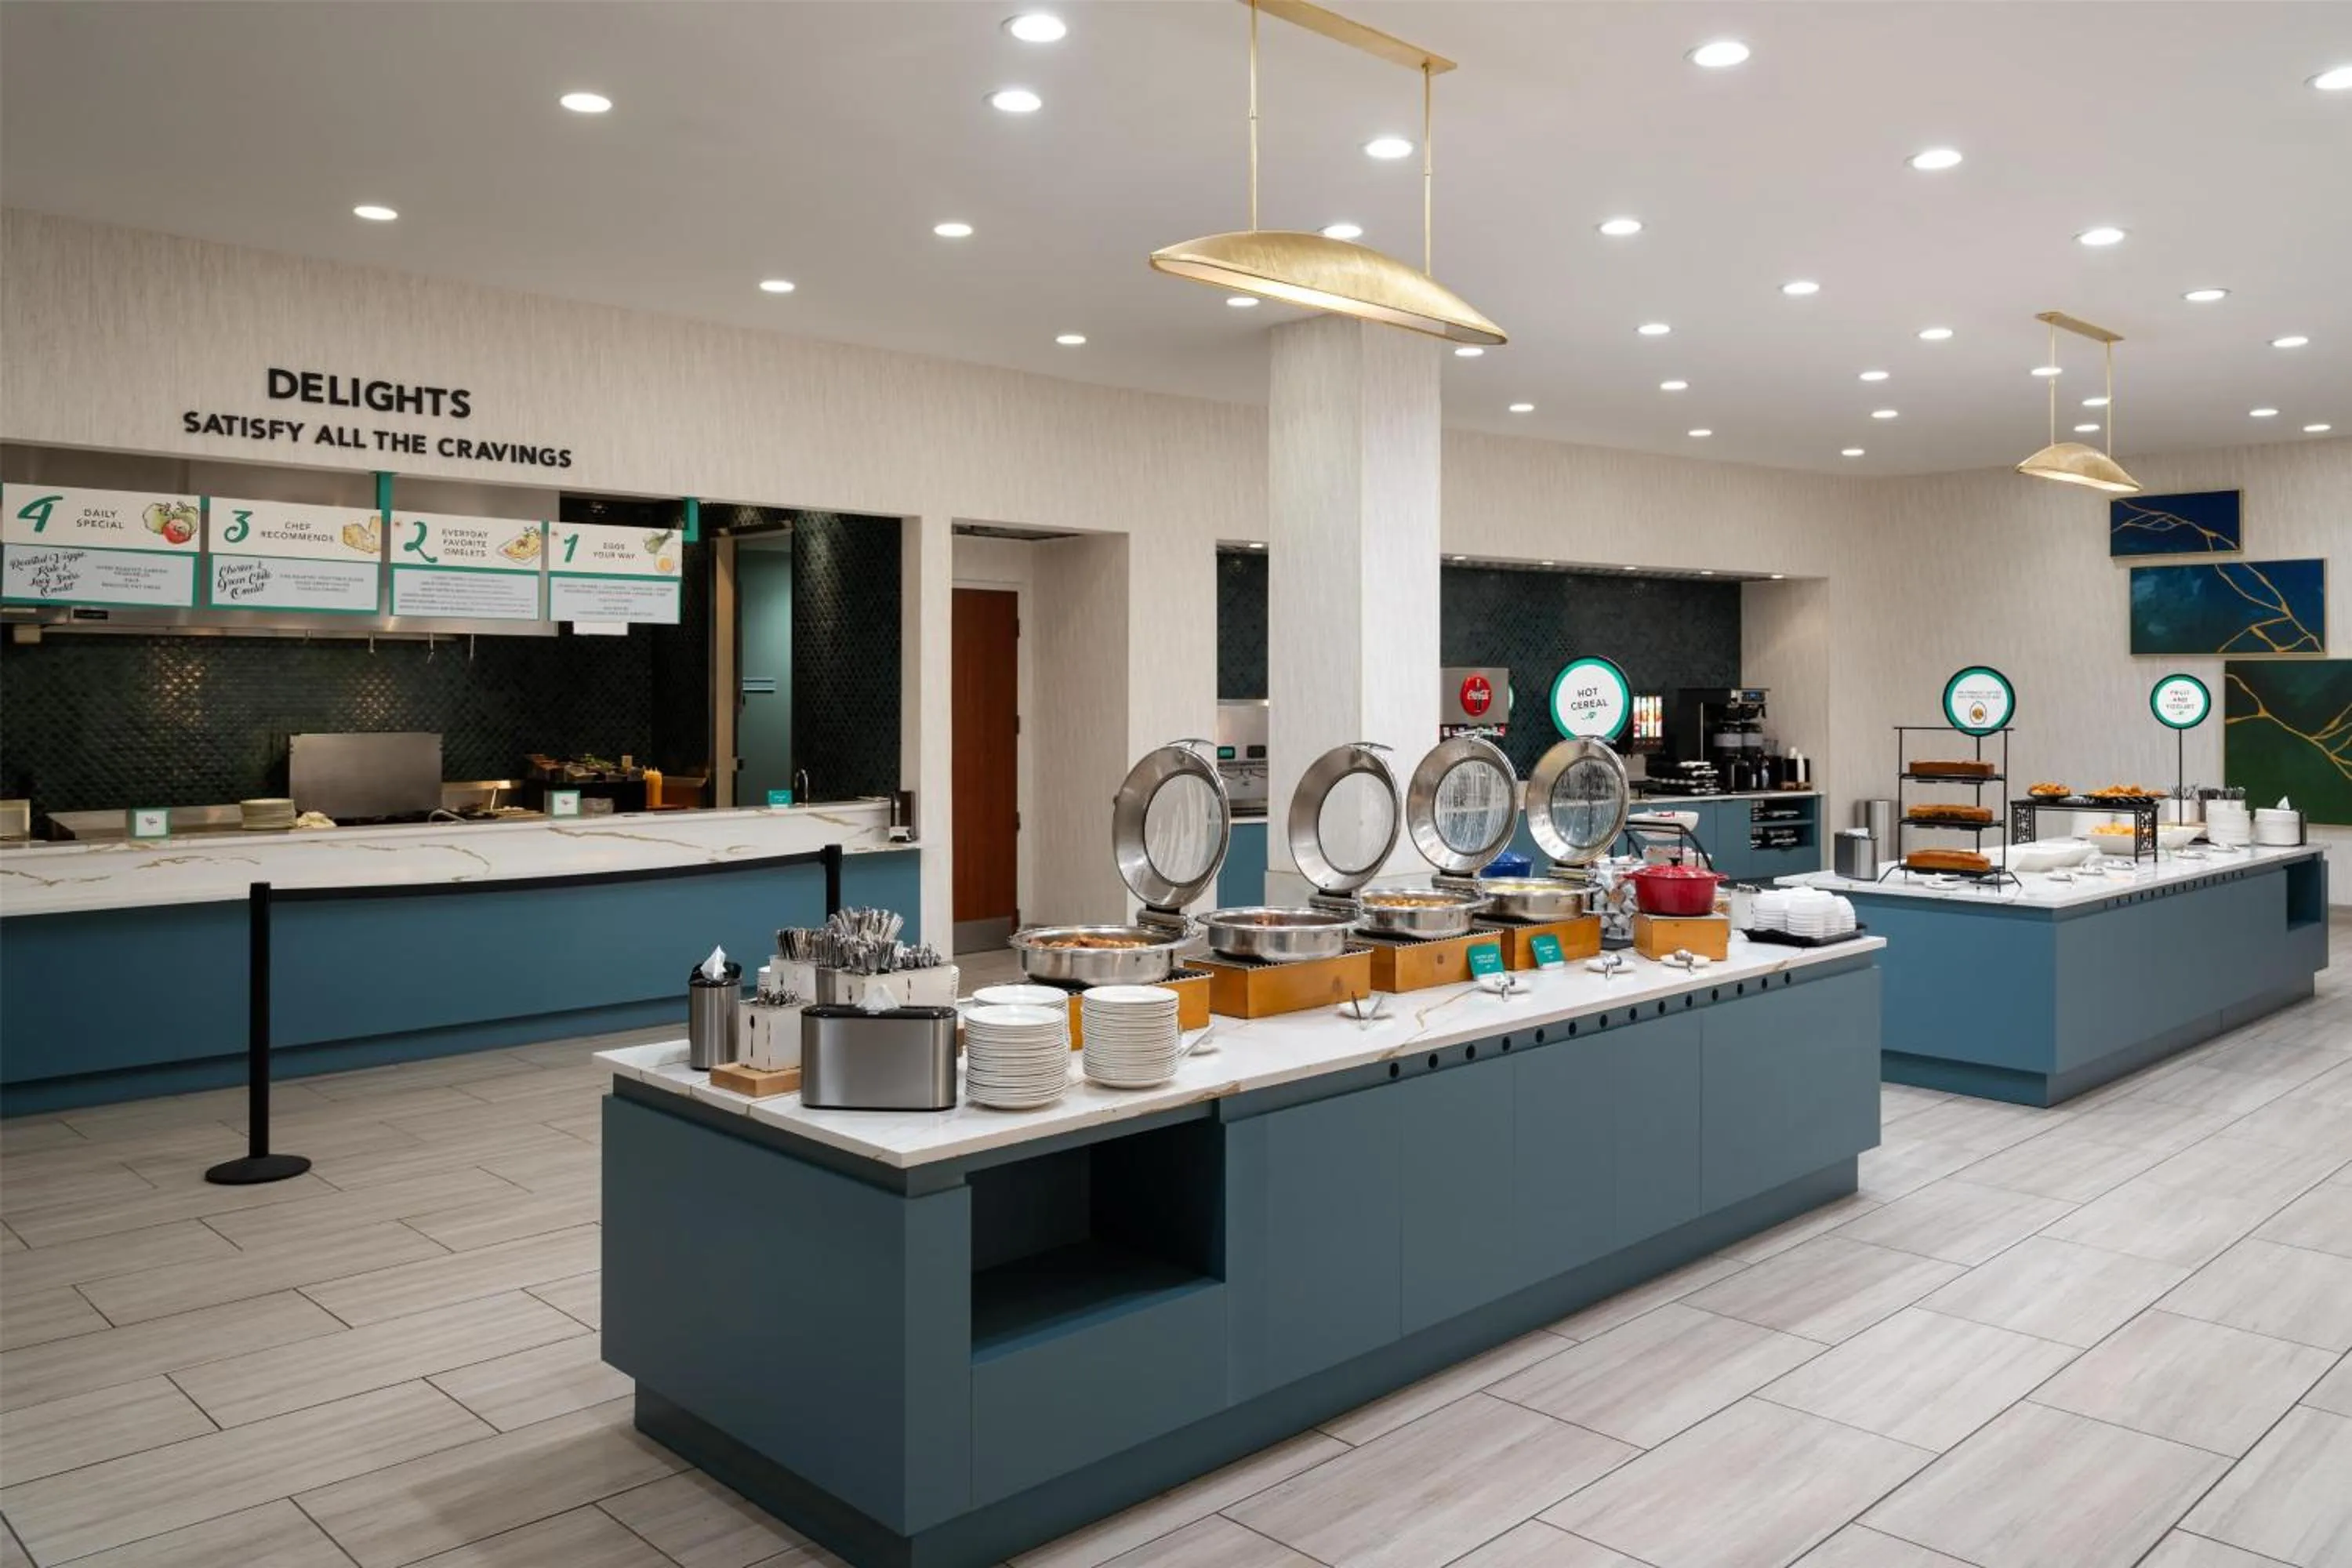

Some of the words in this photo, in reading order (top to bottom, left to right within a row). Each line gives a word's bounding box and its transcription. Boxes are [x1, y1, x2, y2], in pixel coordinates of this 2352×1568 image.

[267, 368, 471, 419] DELIGHTS
[183, 412, 304, 442] SATISFY
[314, 425, 367, 449] ALL
[373, 430, 426, 454] THE
[437, 437, 572, 468] CRAVINGS
[16, 495, 64, 532] 4
[84, 509, 118, 517] DAILY
[76, 519, 125, 529] SPECIAL
[223, 510, 253, 543] 3
[285, 521, 312, 531] CHEF
[260, 531, 335, 543] RECOMMENDS
[441, 528, 489, 539] EVERYDAY
[403, 521, 438, 563] 2
[442, 539, 487, 548] FAVORITE
[603, 542, 626, 550] EGGS
[444, 548, 487, 557] OMELETS
[564, 534, 579, 563] 1
[1577, 687, 1598, 698] HOT
[1570, 699, 1609, 710] CEREAL
